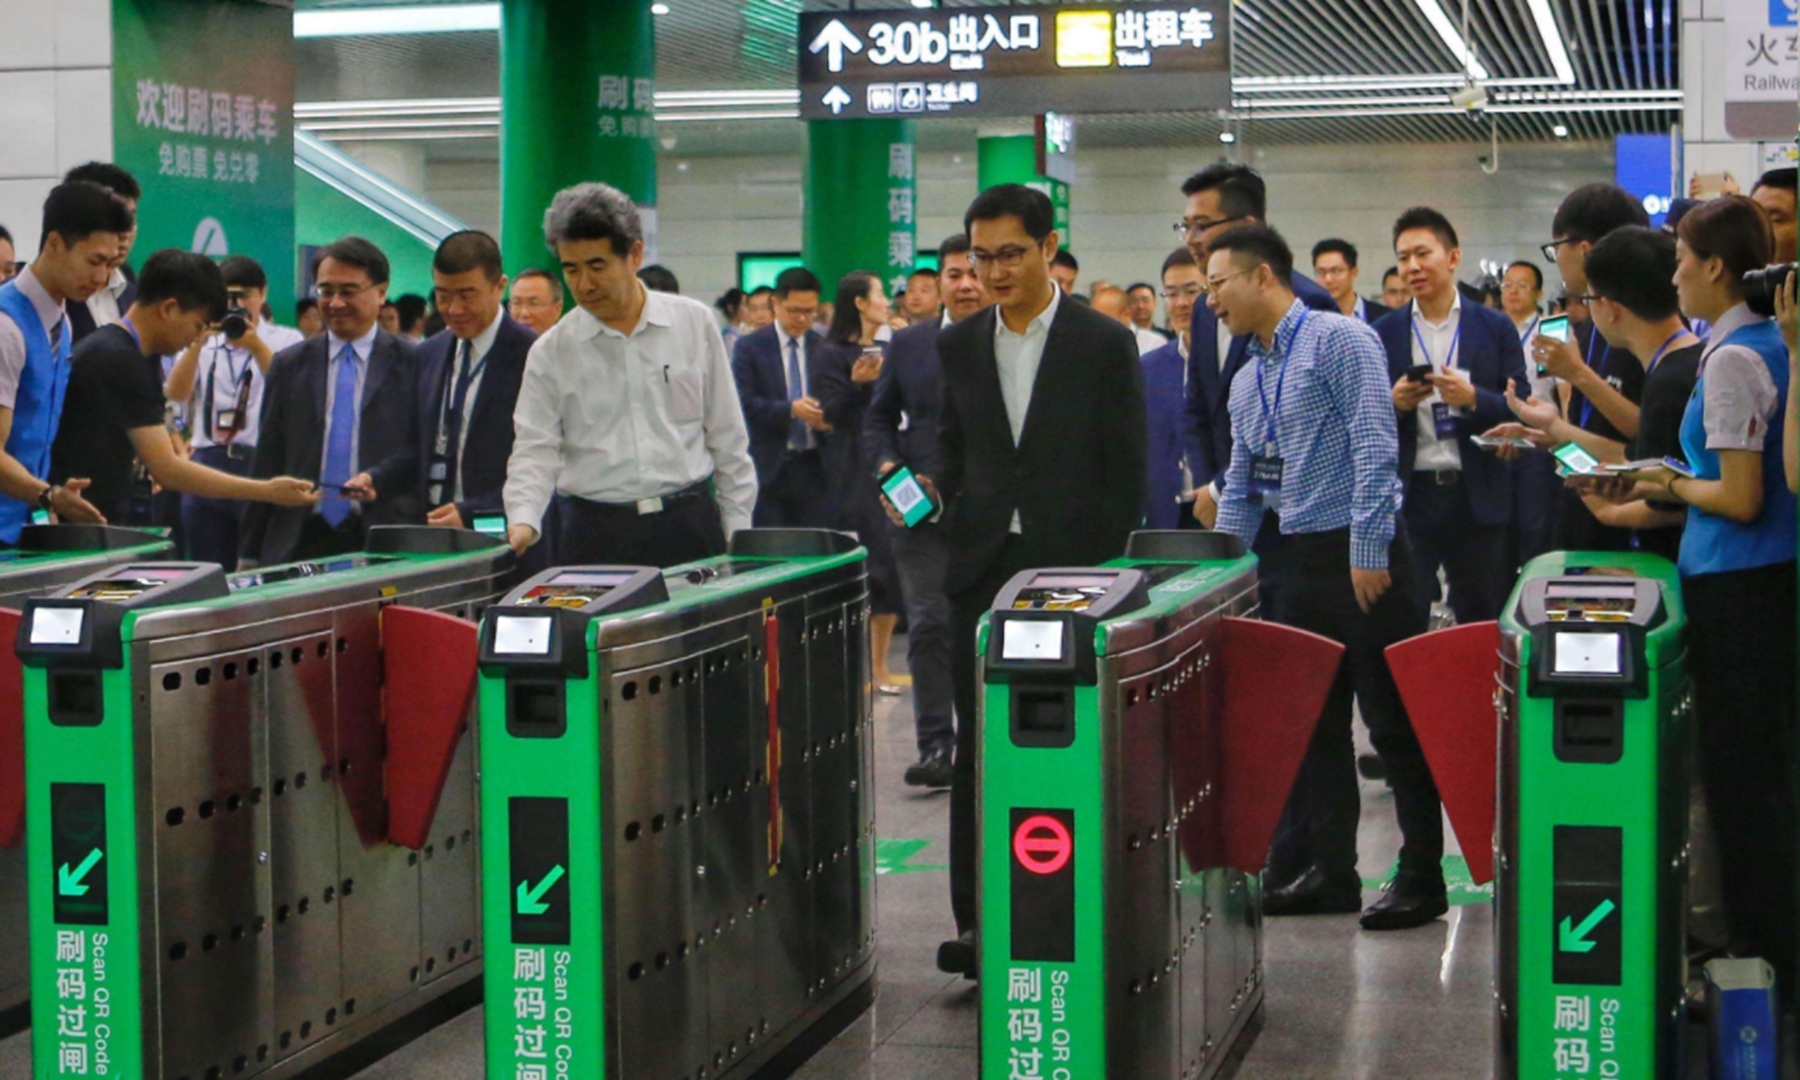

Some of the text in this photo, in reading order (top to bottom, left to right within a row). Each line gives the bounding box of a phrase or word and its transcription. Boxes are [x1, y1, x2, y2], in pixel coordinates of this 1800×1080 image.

[867, 13, 1039, 65] 30b 出入口
[1115, 7, 1214, 48] 出租车
[136, 79, 277, 145] 欢迎刷码乘车
[159, 141, 259, 185] 免购票 免兑零
[553, 950, 571, 1001] Scan
[1050, 970, 1070, 1022] Scan
[56, 930, 87, 1075] 刷码过闸
[92, 932, 111, 1076] Scan QR Code
[554, 1007, 572, 1038] QR
[1007, 967, 1044, 1080] 刷码过
[1051, 1028, 1071, 1062] QR
[1600, 998, 1620, 1080] Scan Q
